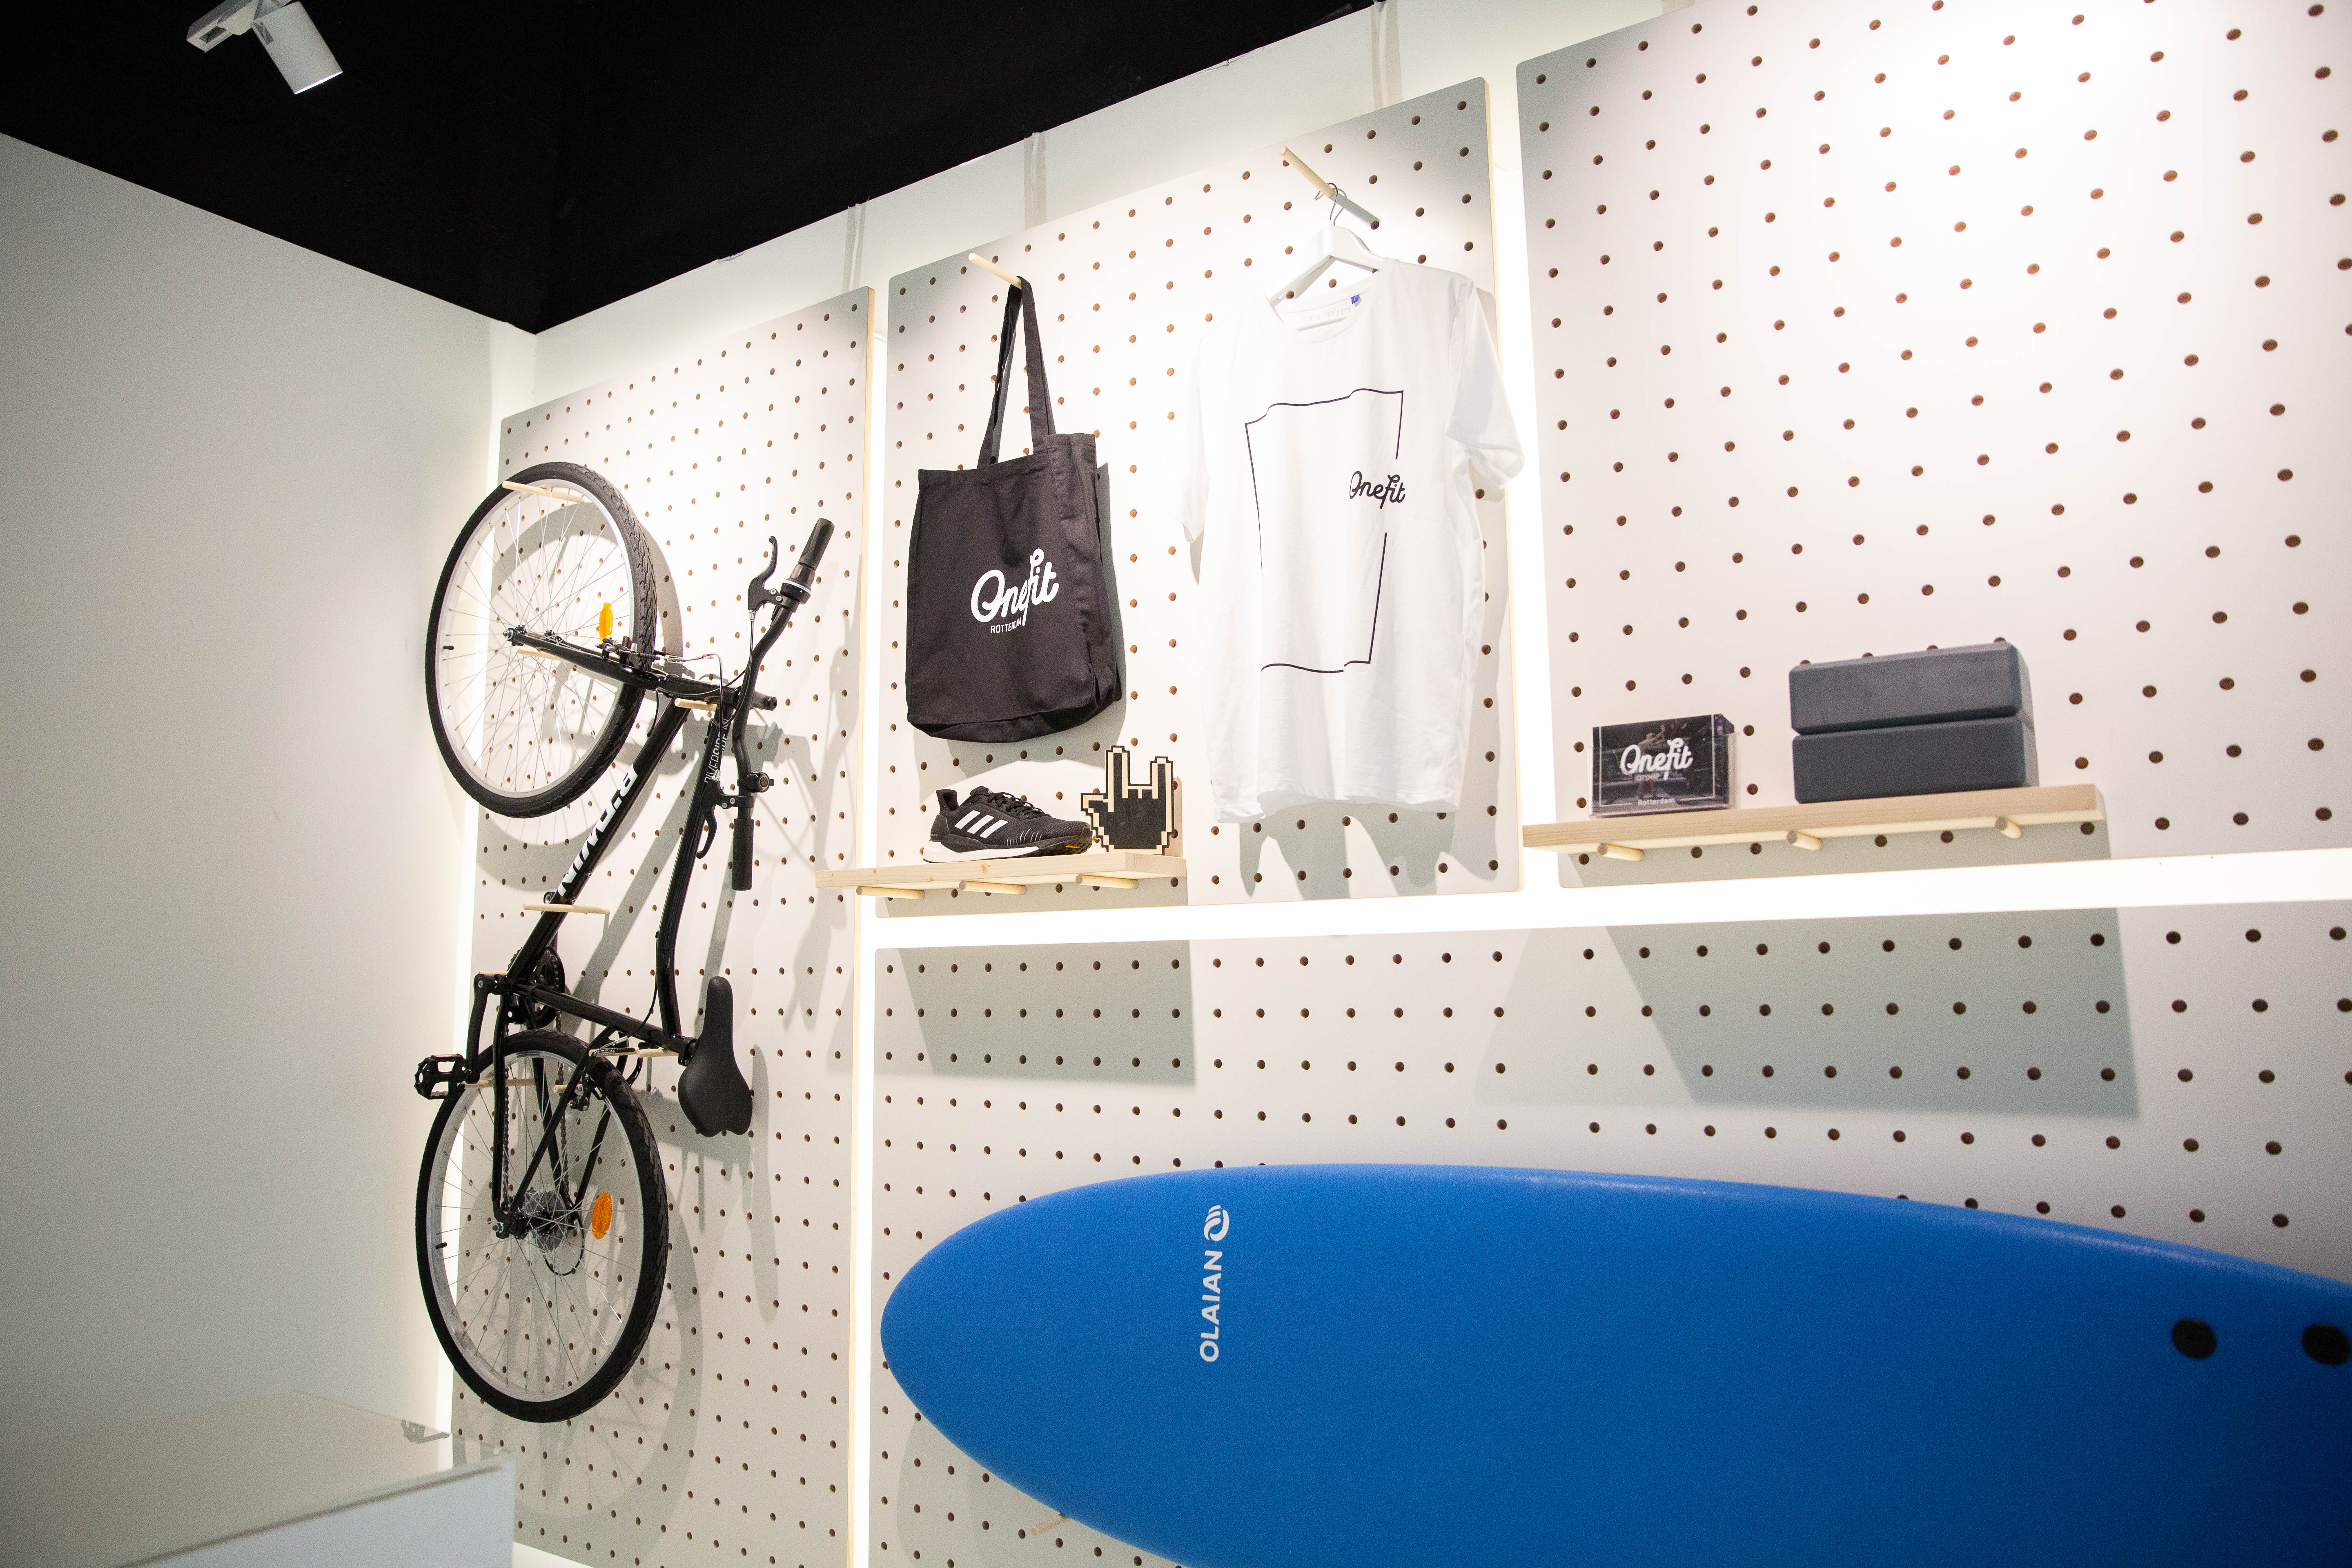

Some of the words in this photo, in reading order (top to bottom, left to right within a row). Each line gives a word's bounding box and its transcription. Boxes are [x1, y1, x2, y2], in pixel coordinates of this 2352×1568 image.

[1350, 471, 1405, 509] Onefit
[971, 548, 1059, 626] Onefit
[990, 617, 1022, 633] ROTTERDAM
[1620, 737, 1693, 780] Onefit
[1200, 1250, 1223, 1362] OLAIAN
